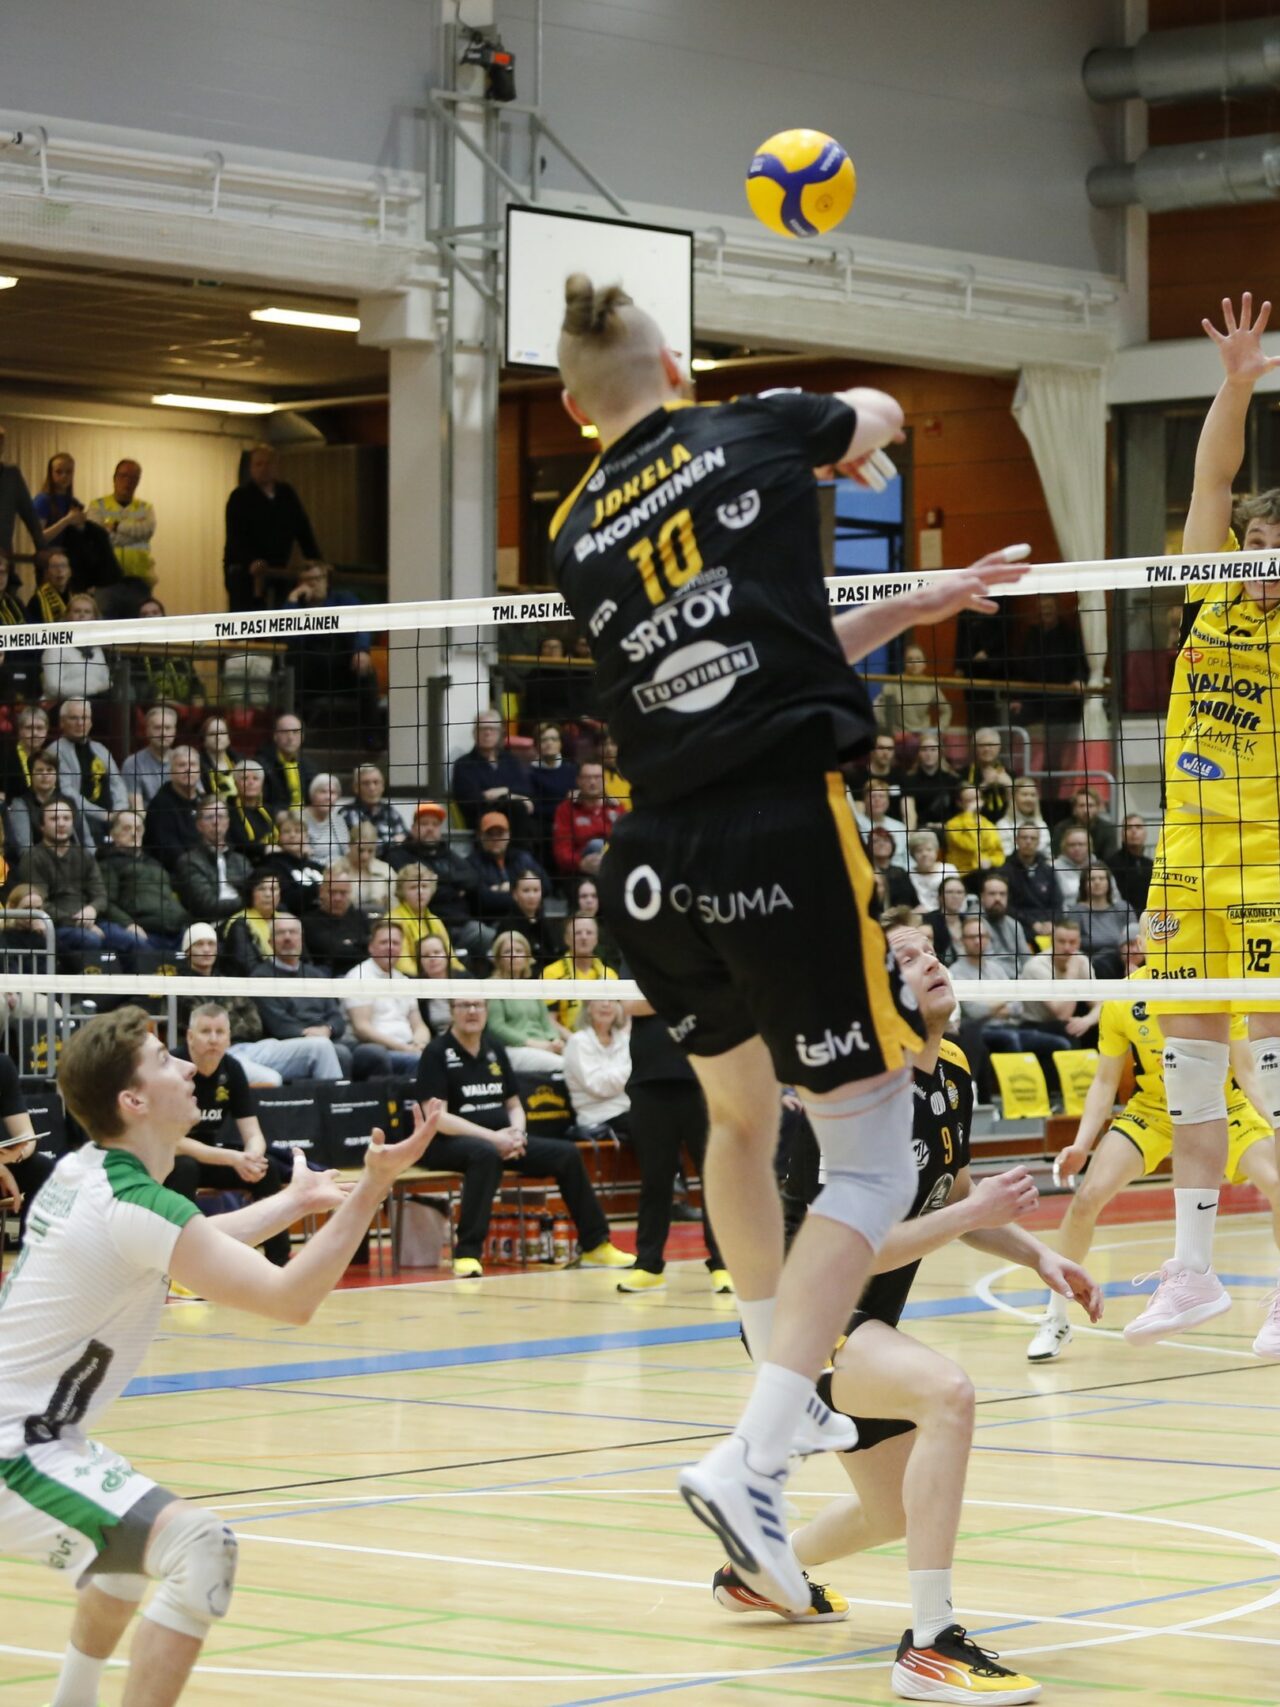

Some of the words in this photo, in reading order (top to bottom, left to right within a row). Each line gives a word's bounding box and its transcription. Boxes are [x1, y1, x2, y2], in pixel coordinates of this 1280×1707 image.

[591, 443, 692, 529] JOKELA
[594, 446, 726, 554] KONTTINEN
[627, 507, 705, 607] 10
[1146, 565, 1177, 583] TMI.
[1180, 563, 1216, 581] PASI
[838, 585, 868, 602] PASI
[215, 622, 238, 637] TMI.
[240, 619, 266, 635] PASI
[269, 614, 340, 634] MERILÄINEN
[492, 604, 518, 621] TMI.
[520, 602, 549, 619] PASI
[10, 629, 73, 647] MERILÄINEN
[643, 651, 750, 704] TUOVINEN
[1186, 672, 1267, 705] VALLOX
[670, 883, 794, 924] OSUMA
[1247, 938, 1272, 972] 12
[1151, 966, 1197, 979] Rauta
[461, 1082, 503, 1098] VALLOX
[940, 1126, 953, 1165] 9
